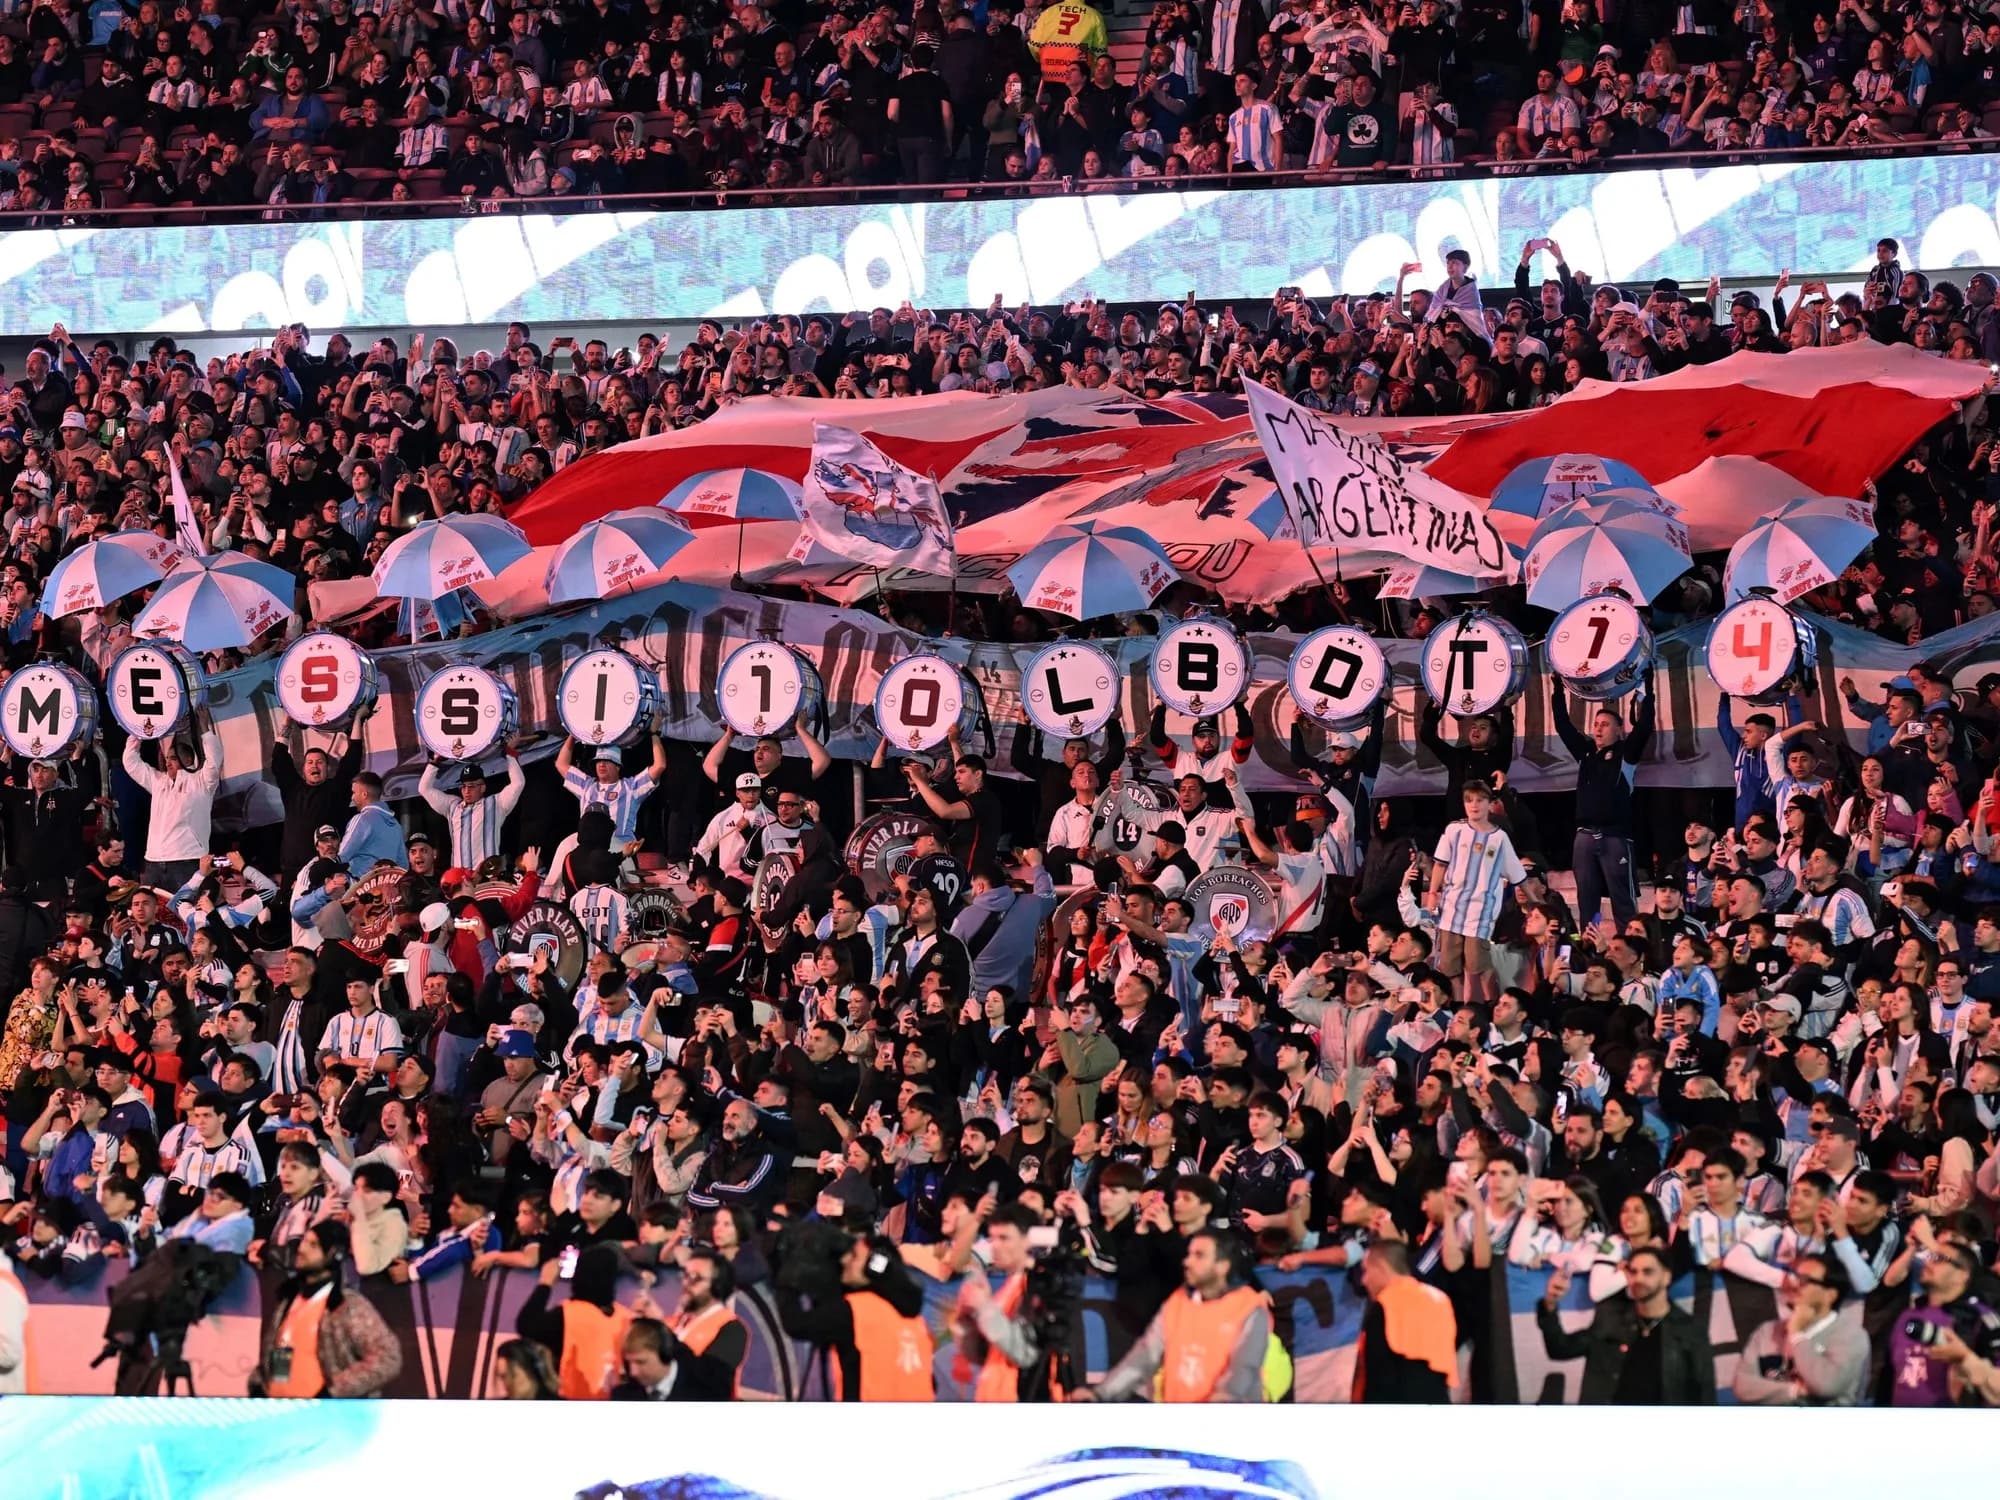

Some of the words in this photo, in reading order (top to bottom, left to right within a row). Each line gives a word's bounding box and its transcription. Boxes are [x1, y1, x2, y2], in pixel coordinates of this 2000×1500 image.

[1058, 5, 1087, 14] TECH
[1057, 12, 1081, 36] 3
[718, 504, 727, 514] 14
[473, 570, 485, 581] 14
[635, 565, 646, 577] 14
[1161, 571, 1172, 584] 14
[1811, 572, 1825, 586] 14
[87, 595, 96, 606] 14
[1062, 602, 1073, 614] 14
[268, 610, 282, 624] 14
[1586, 617, 1610, 659] 1
[1732, 621, 1772, 672] 4
[301, 655, 339, 703] S
[1177, 641, 1219, 692] B
[1449, 640, 1488, 690] T
[129, 667, 164, 715] E
[750, 664, 772, 713] 1
[1045, 667, 1095, 716] L
[18, 686, 62, 736] M
[440, 687, 480, 736] S
[1116, 818, 1138, 843] 14
[863, 826, 893, 870] RIVER
[893, 820, 920, 836] PLA
[935, 859, 955, 868] MESSI
[1190, 881, 1207, 903] LOS
[1207, 873, 1268, 905] BORRACHOS
[511, 908, 545, 945] RIVER
[546, 907, 580, 946] PLATE
[576, 906, 611, 919] BDT
